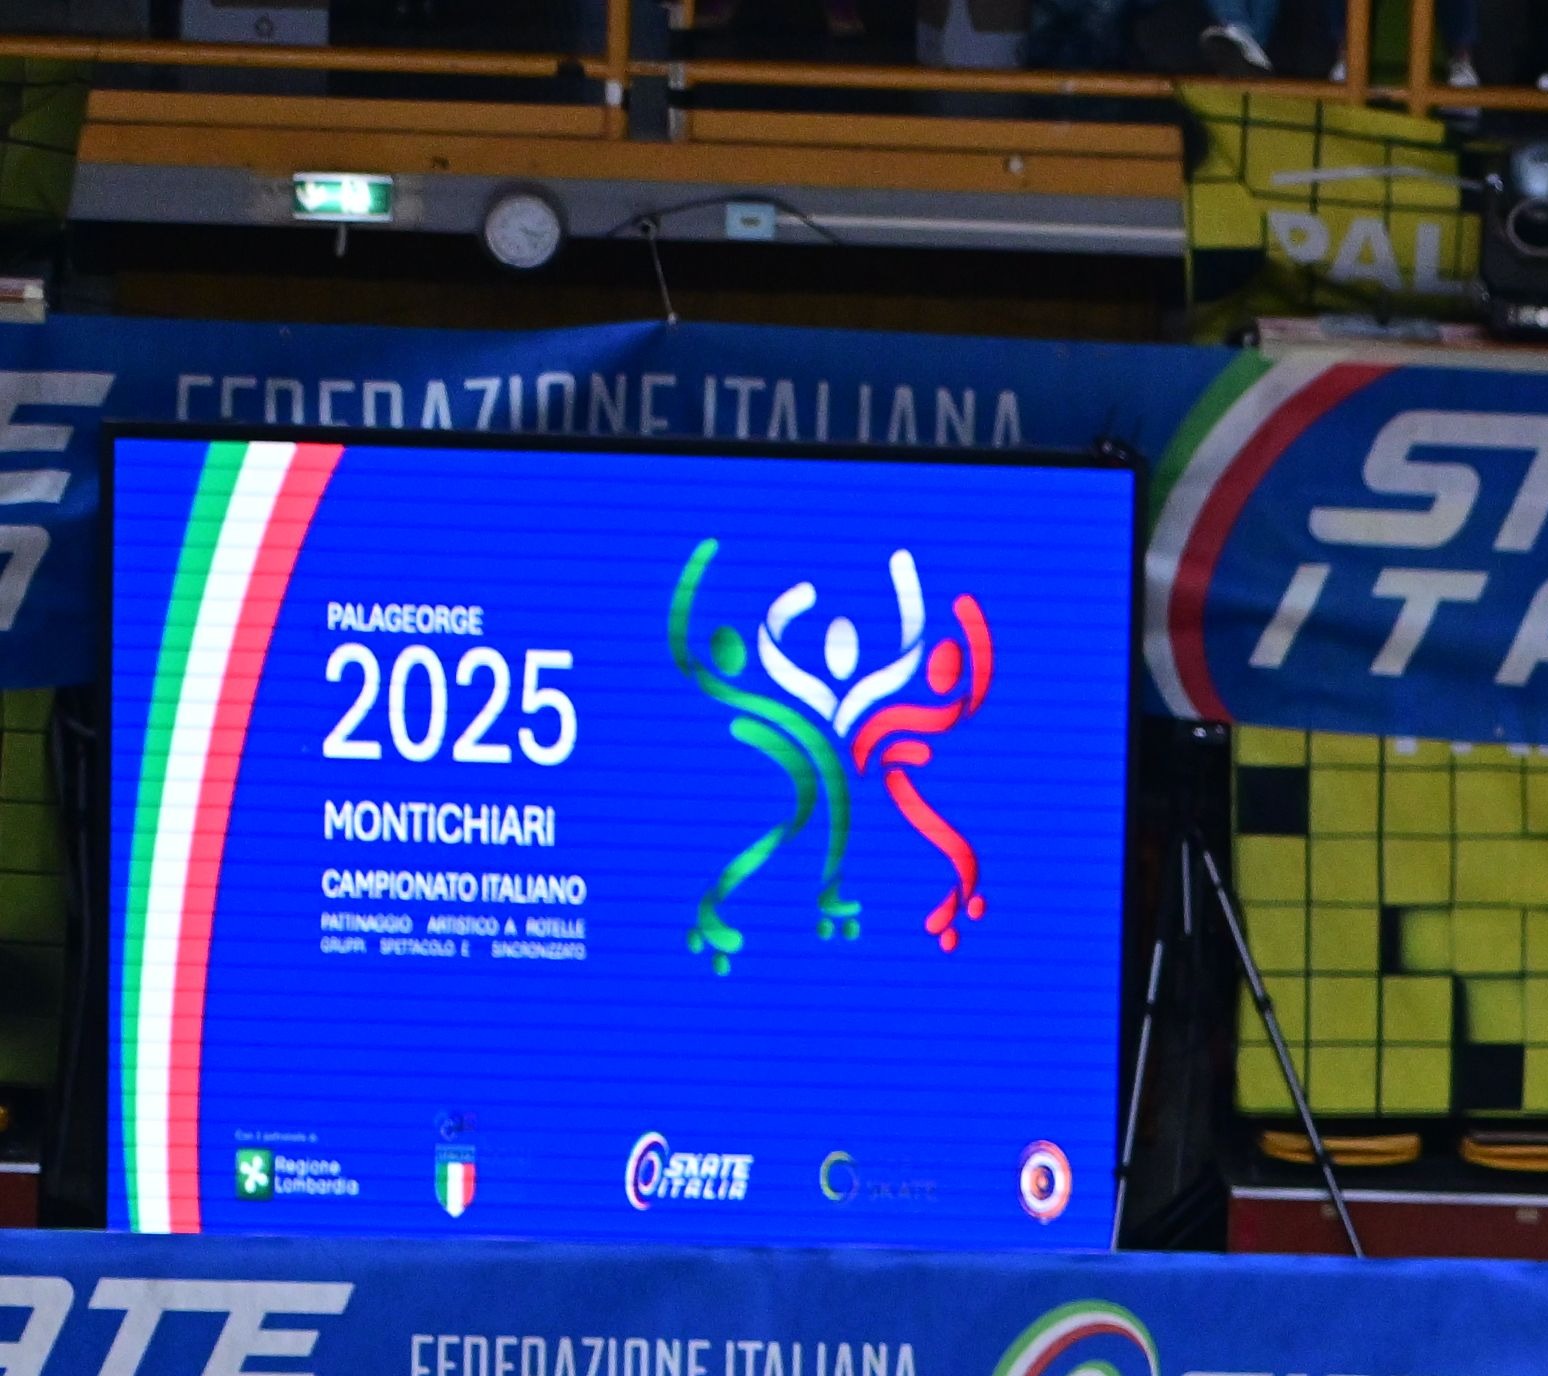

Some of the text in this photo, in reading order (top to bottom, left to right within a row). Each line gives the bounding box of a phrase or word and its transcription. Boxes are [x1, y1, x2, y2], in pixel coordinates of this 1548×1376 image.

[327, 602, 484, 635] PALAGEORGE
[322, 642, 578, 766] 2025
[324, 799, 555, 846] MONTICHIARI
[321, 868, 586, 906] CAMPIONATO ITALIANO
[275, 1155, 341, 1176] Regione
[665, 1153, 753, 1180] SKATE
[274, 1176, 360, 1196] Lombardia
[658, 1177, 747, 1200] ITALIA
